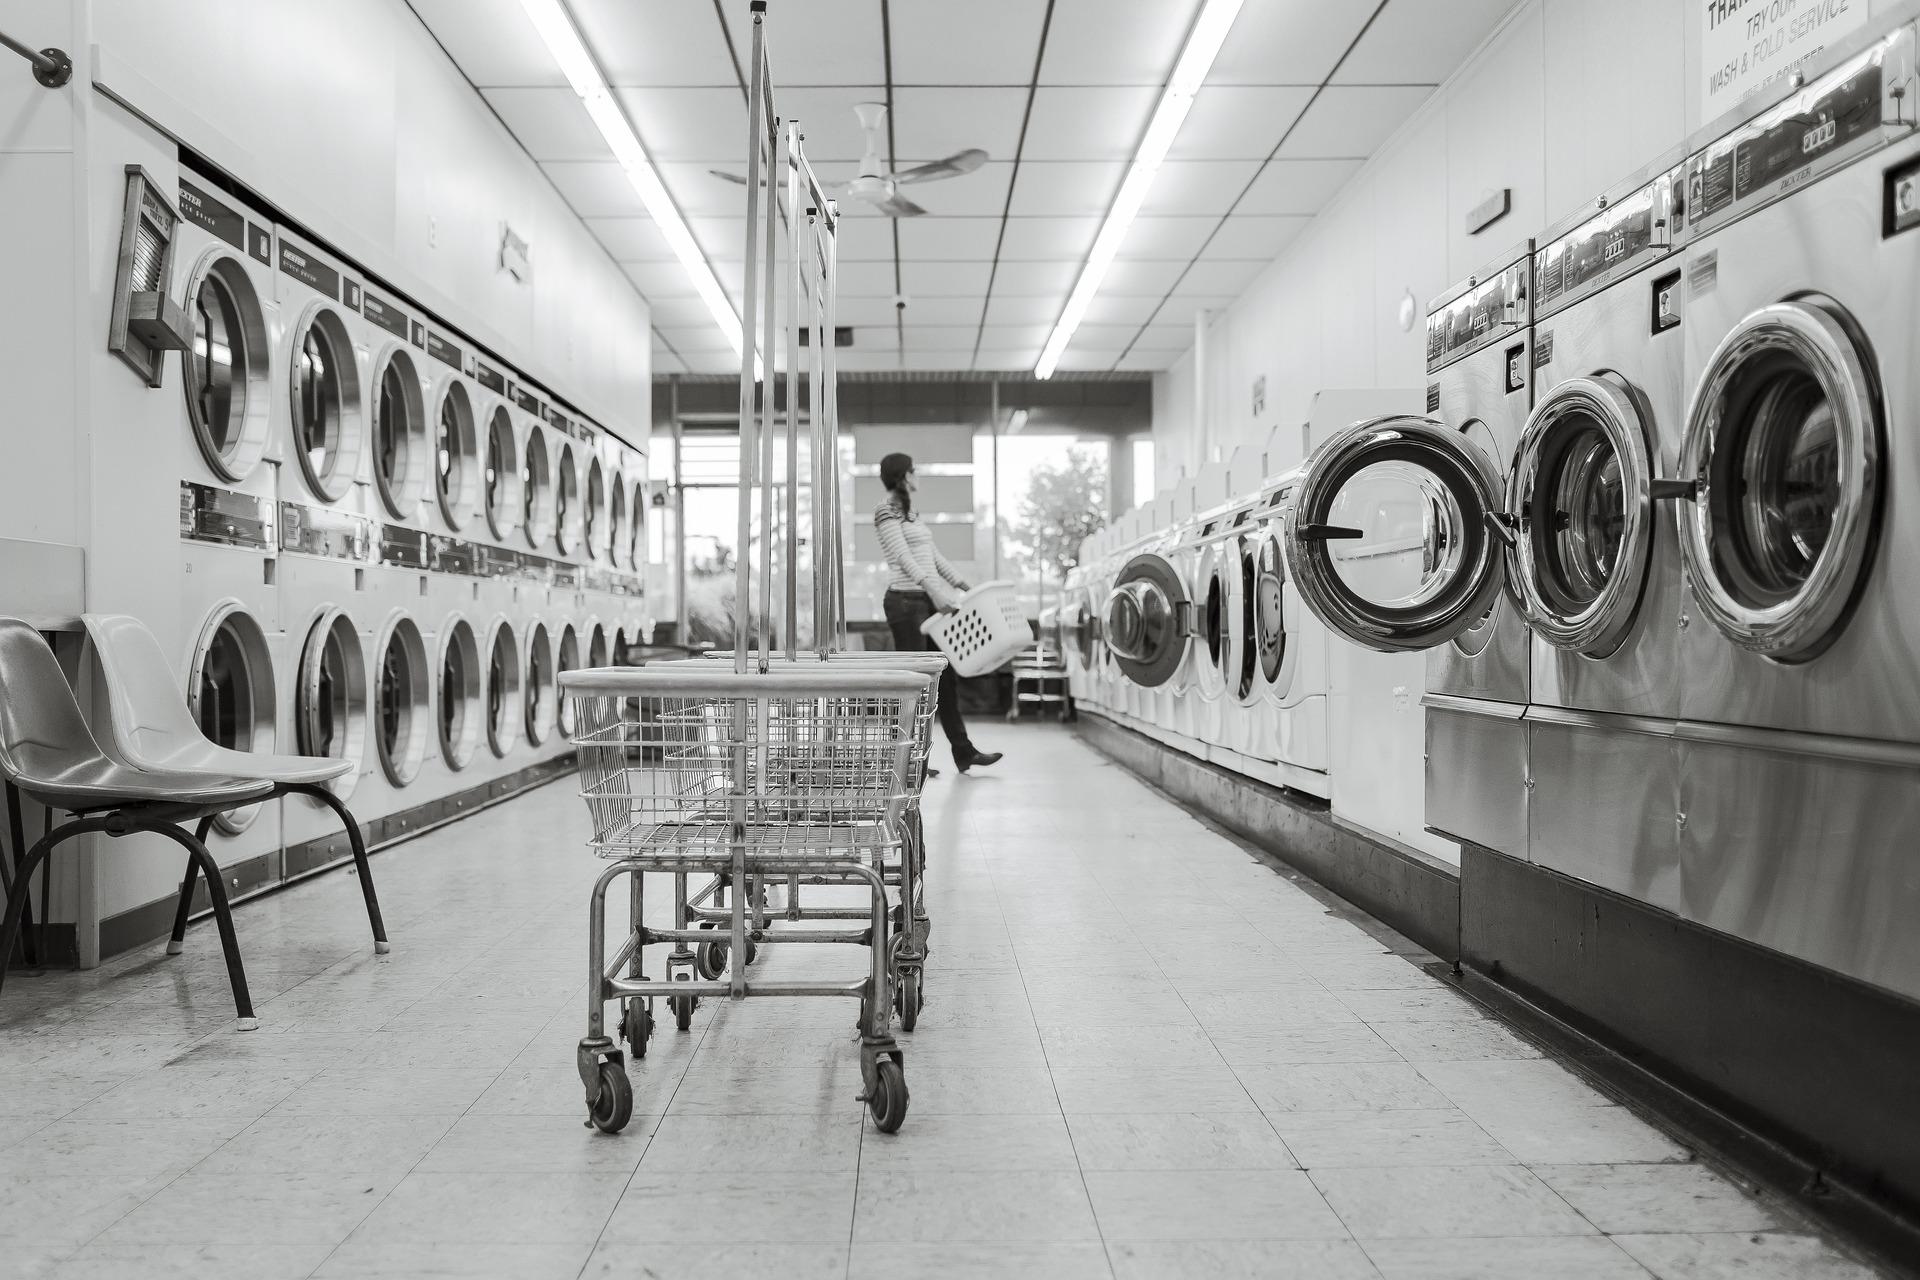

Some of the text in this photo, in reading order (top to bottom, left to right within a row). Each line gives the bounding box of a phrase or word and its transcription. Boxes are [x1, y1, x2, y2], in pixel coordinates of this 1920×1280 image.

[1747, 5, 1769, 40] TRY
[1709, 0, 1849, 96] WASH & FOLD SERVICE
[179, 188, 202, 208] EXTER
